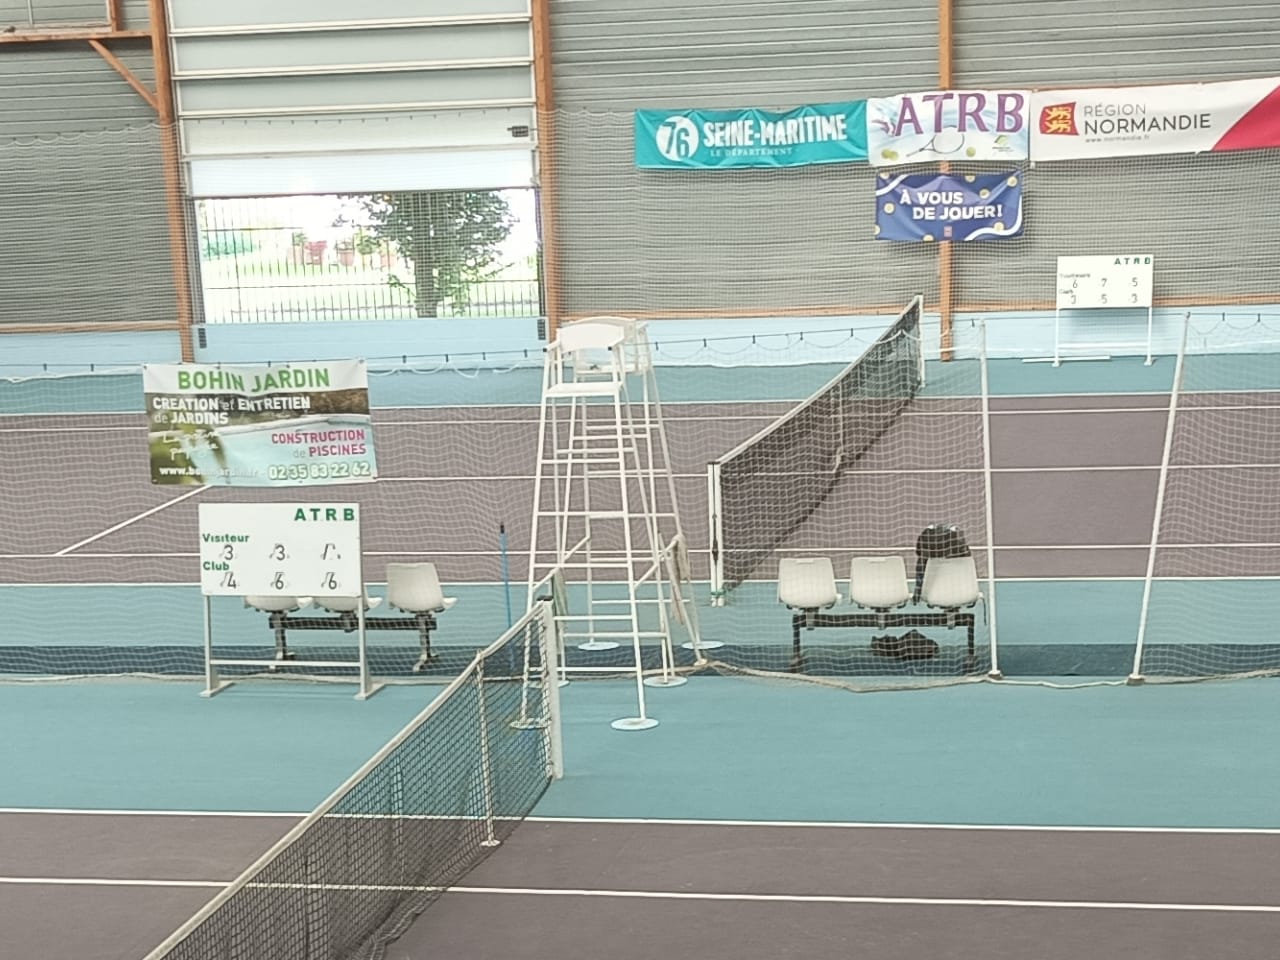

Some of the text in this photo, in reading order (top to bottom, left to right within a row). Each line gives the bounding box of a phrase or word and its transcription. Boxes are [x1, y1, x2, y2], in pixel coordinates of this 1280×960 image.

[894, 93, 1025, 137] ATRB
[1084, 103, 1146, 117] RÉGION
[703, 114, 848, 147] SEINE-MARITIME
[1084, 113, 1211, 135] NORMANDIE
[660, 121, 690, 160] 76
[900, 189, 964, 205] À VOUS
[913, 206, 935, 220] DE
[178, 368, 329, 392] BOHIN JARDIN
[152, 396, 310, 412] CREATION et ENTRETIEN
[154, 411, 229, 424] de JARDINS
[271, 429, 365, 444] CONSTRUCTION
[293, 443, 366, 458] de PISCINES
[269, 465, 287, 480] 02
[289, 464, 307, 479] 35
[331, 462, 349, 478] 22
[352, 461, 370, 476] 62
[202, 533, 250, 543] Visiteur
[224, 544, 286, 561] 3 3
[203, 561, 230, 571] Club
[227, 572, 338, 590] 4 6 6
